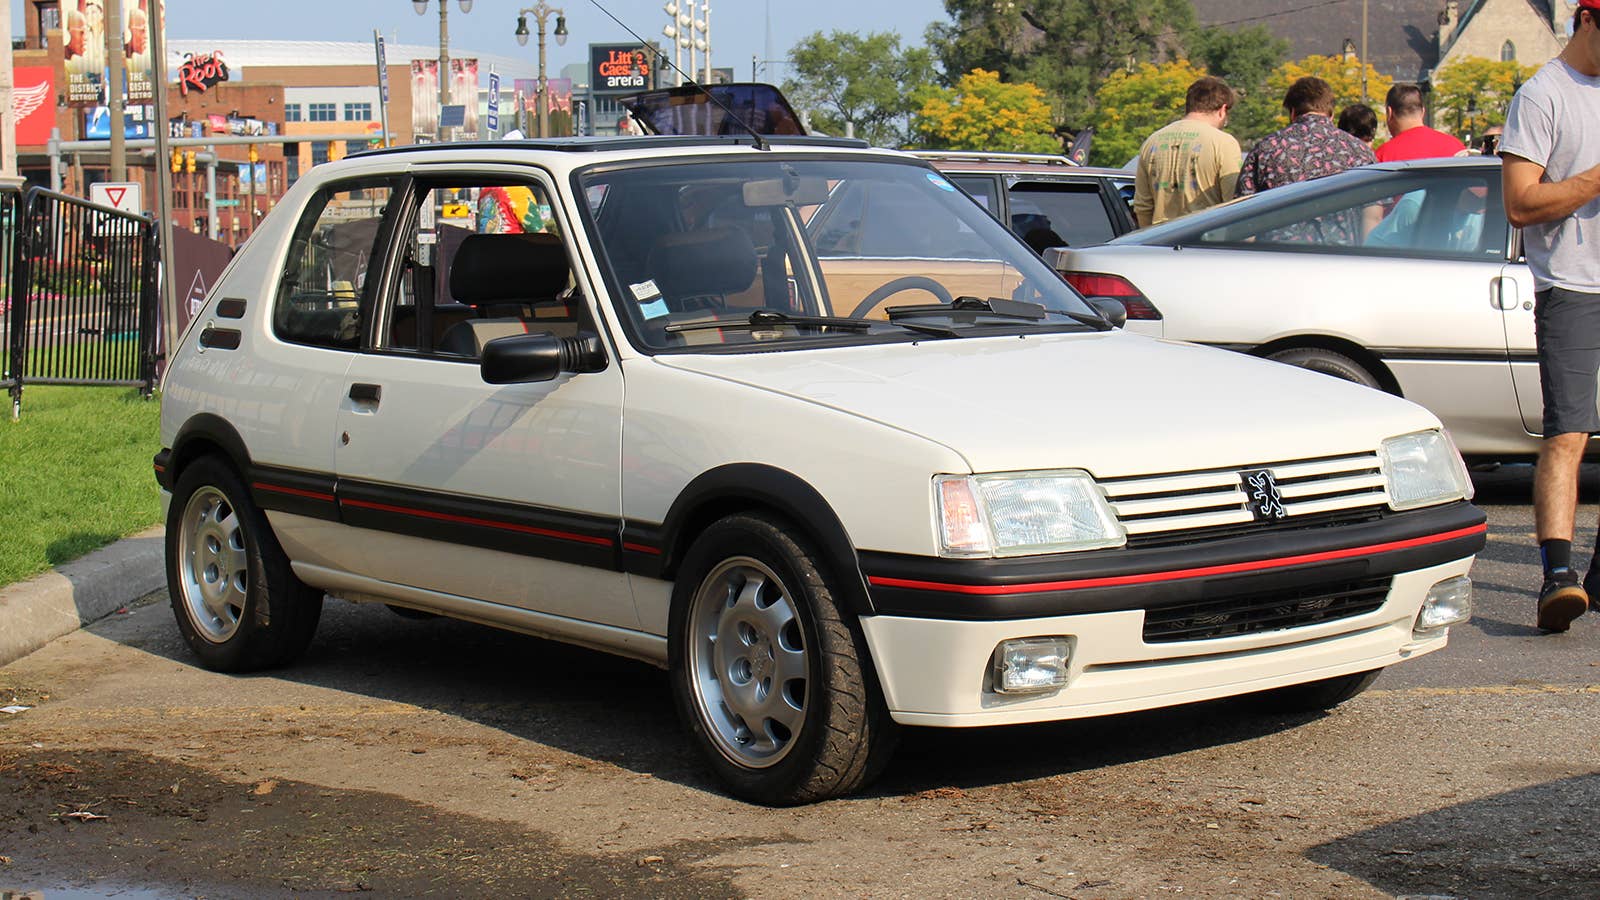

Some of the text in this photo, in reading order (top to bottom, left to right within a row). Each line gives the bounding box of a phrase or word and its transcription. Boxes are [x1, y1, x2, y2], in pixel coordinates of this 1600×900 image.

[609, 50, 643, 64] Litte
[177, 50, 224, 95] Roof
[599, 61, 648, 76] Caess
[70, 74, 83, 83] THE
[130, 72, 142, 81] THE
[607, 75, 644, 87] arena
[70, 83, 102, 93] DISTRICT
[129, 81, 152, 92] DISTR
[70, 93, 98, 101] DETROIT
[129, 91, 152, 99] DETRO
